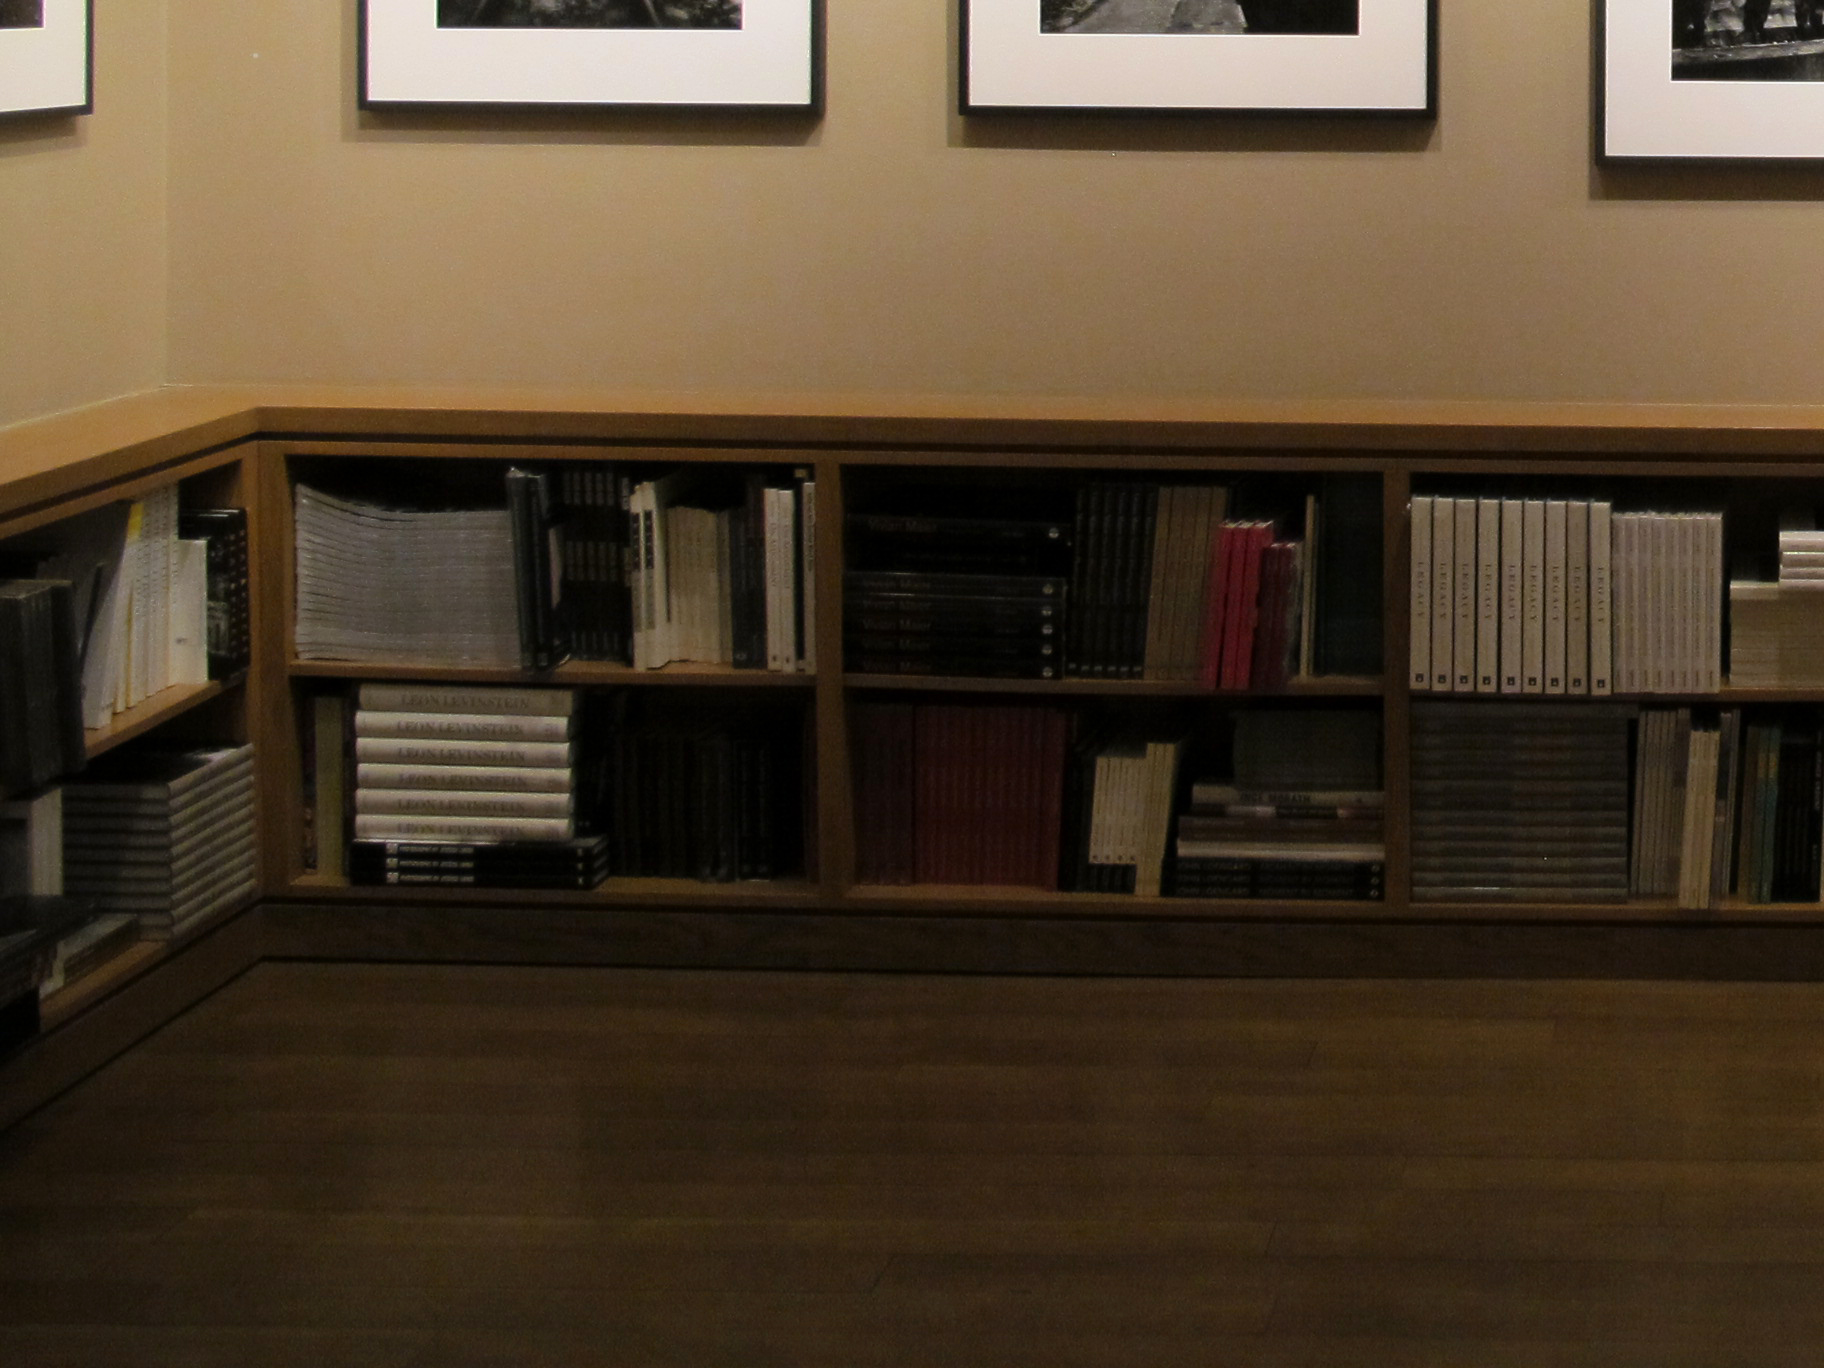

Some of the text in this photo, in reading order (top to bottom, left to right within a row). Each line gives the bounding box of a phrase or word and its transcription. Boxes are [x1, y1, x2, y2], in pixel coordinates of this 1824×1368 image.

[1417, 562, 1425, 617] LEGACY
[1439, 563, 1447, 619] LEGACY
[1461, 563, 1469, 619] LEGACY
[1484, 564, 1492, 619] LEGACY
[1508, 565, 1516, 620] LEGACY
[1530, 565, 1538, 622] LEGACY
[1552, 566, 1560, 621] LEGACY
[1574, 566, 1582, 622] LEGACY
[1597, 567, 1605, 622] LEGACY
[397, 720, 525, 736] LEON LEVINSTEIN
[401, 693, 530, 710] LEON LEVINSTEIN
[398, 746, 526, 762] LEON LEVINSTEIN
[398, 773, 437, 785] LEON
